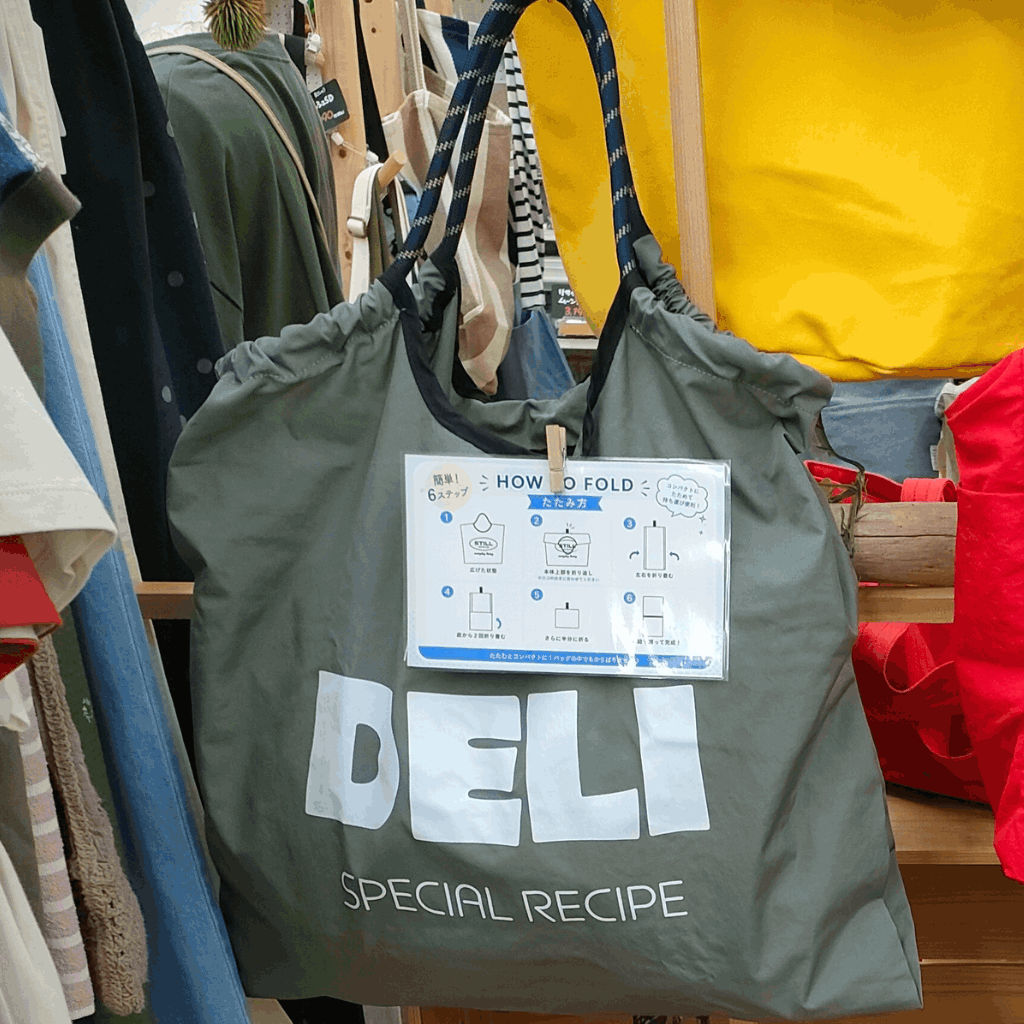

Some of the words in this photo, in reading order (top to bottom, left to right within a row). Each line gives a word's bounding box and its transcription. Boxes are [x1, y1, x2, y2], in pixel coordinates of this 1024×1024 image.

[497, 475, 543, 489] HOW
[584, 477, 634, 492] FOLD
[667, 483, 699, 494] コンパクトに
[428, 487, 469, 501] 6ステップ
[671, 491, 693, 501] たためて
[542, 497, 588, 509] たたみ方
[305, 670, 711, 847] DELI
[340, 871, 514, 922] SPECIAL
[522, 880, 689, 923] RECIPE
